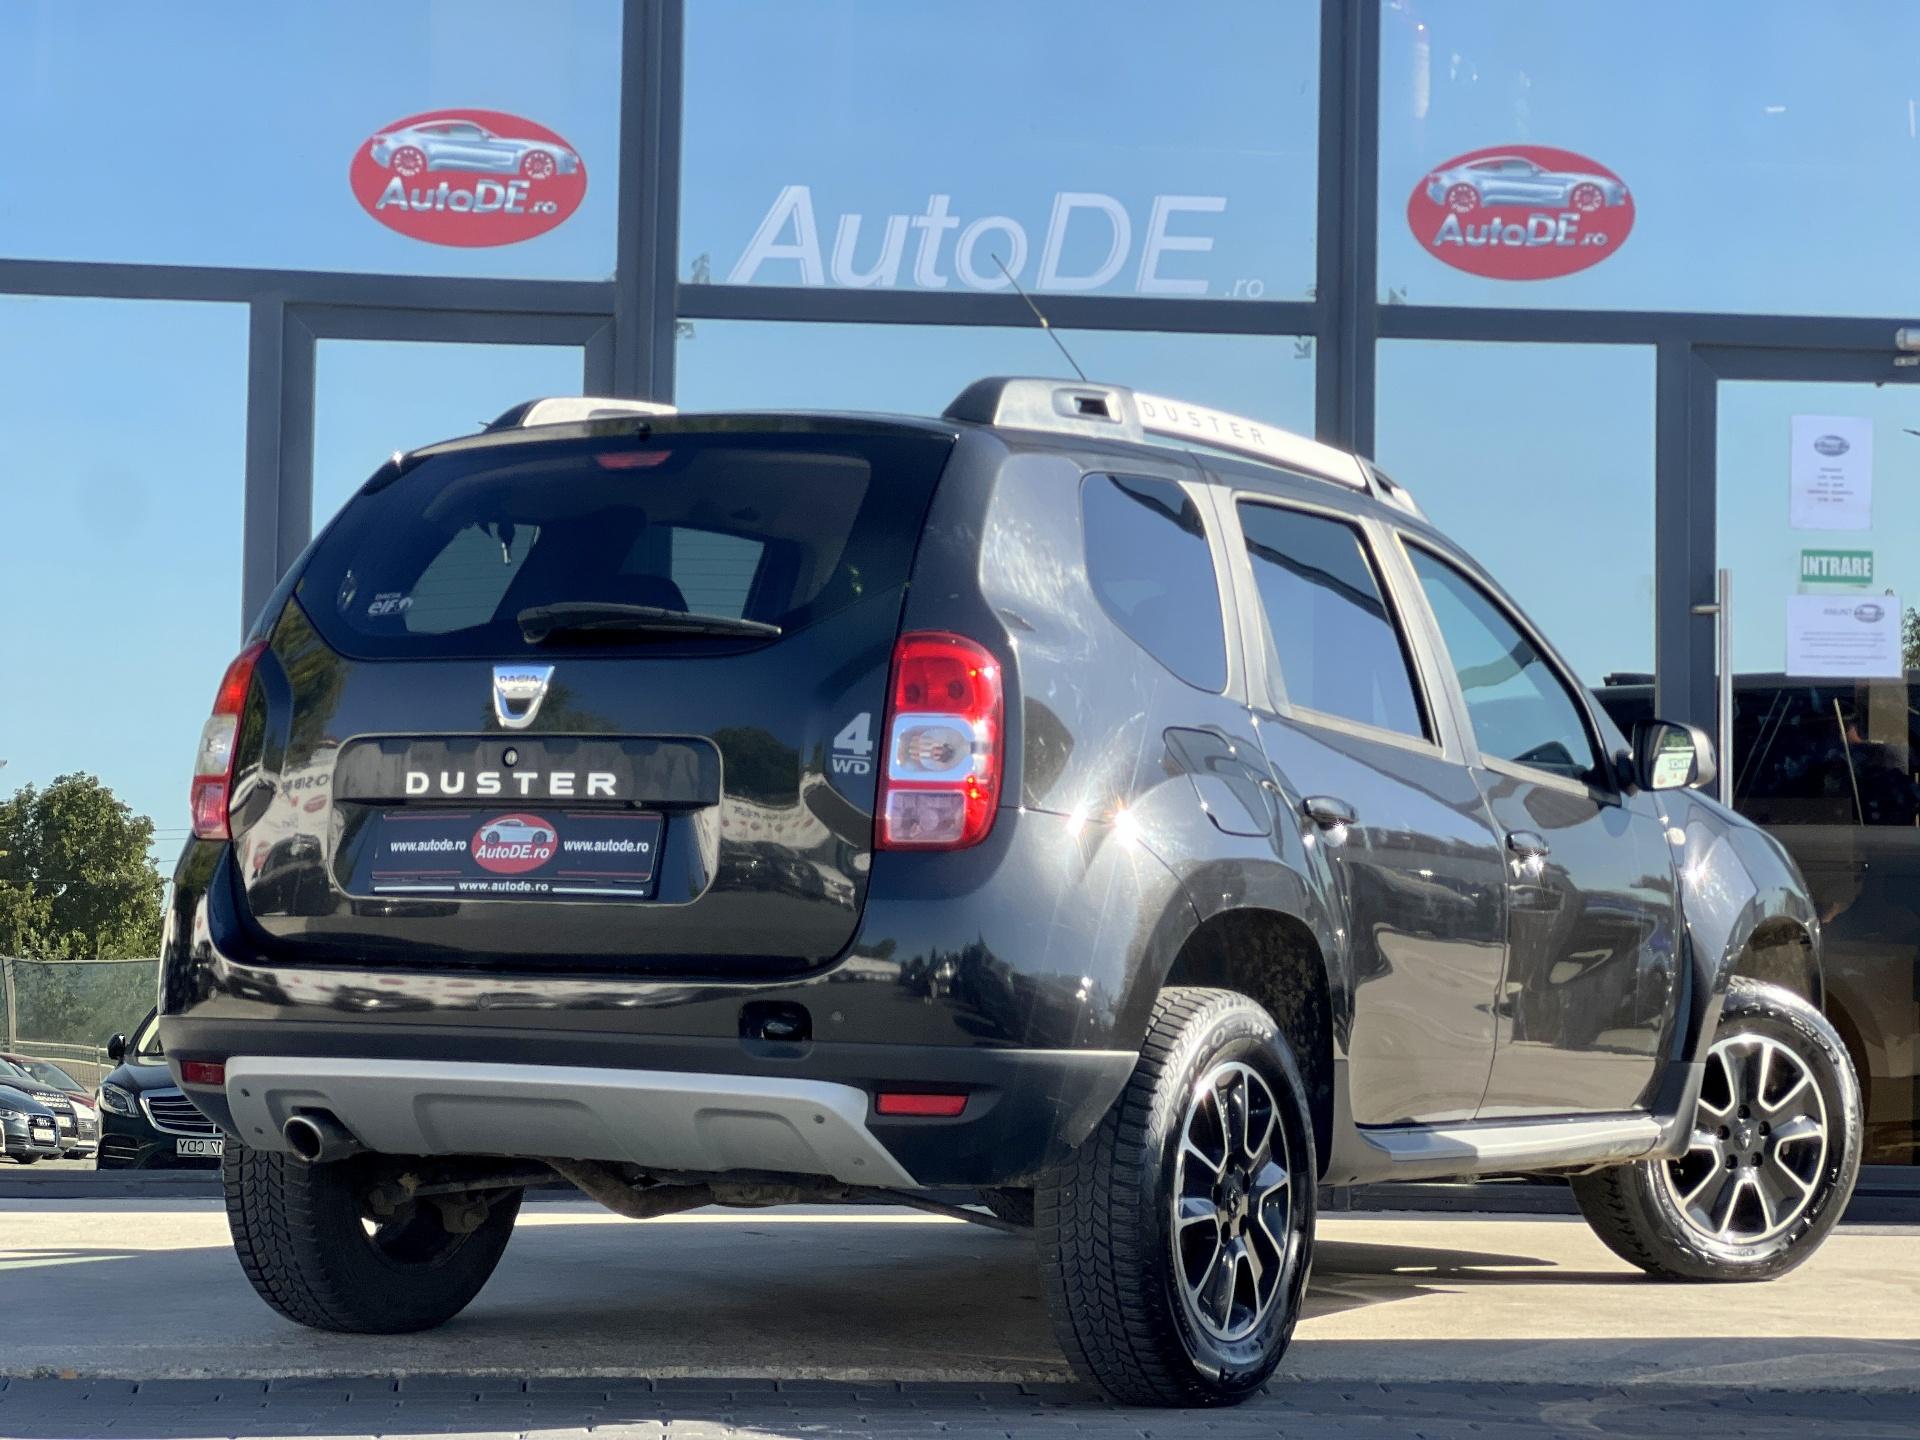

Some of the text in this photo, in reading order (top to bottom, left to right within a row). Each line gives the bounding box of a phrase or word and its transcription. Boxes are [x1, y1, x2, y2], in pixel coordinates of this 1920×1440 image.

[1142, 401, 1266, 446] DUSTER
[1802, 556, 1872, 578] INTRARE
[499, 674, 539, 683] DACIA
[832, 711, 873, 756] 4
[831, 758, 871, 776] WD
[405, 771, 618, 797] DUSTER
[390, 839, 467, 852] www.autode.ro
[475, 843, 550, 860] AutoDE.ro
[563, 838, 650, 853] www.autode.ro
[458, 880, 549, 893] www.autode.ro
